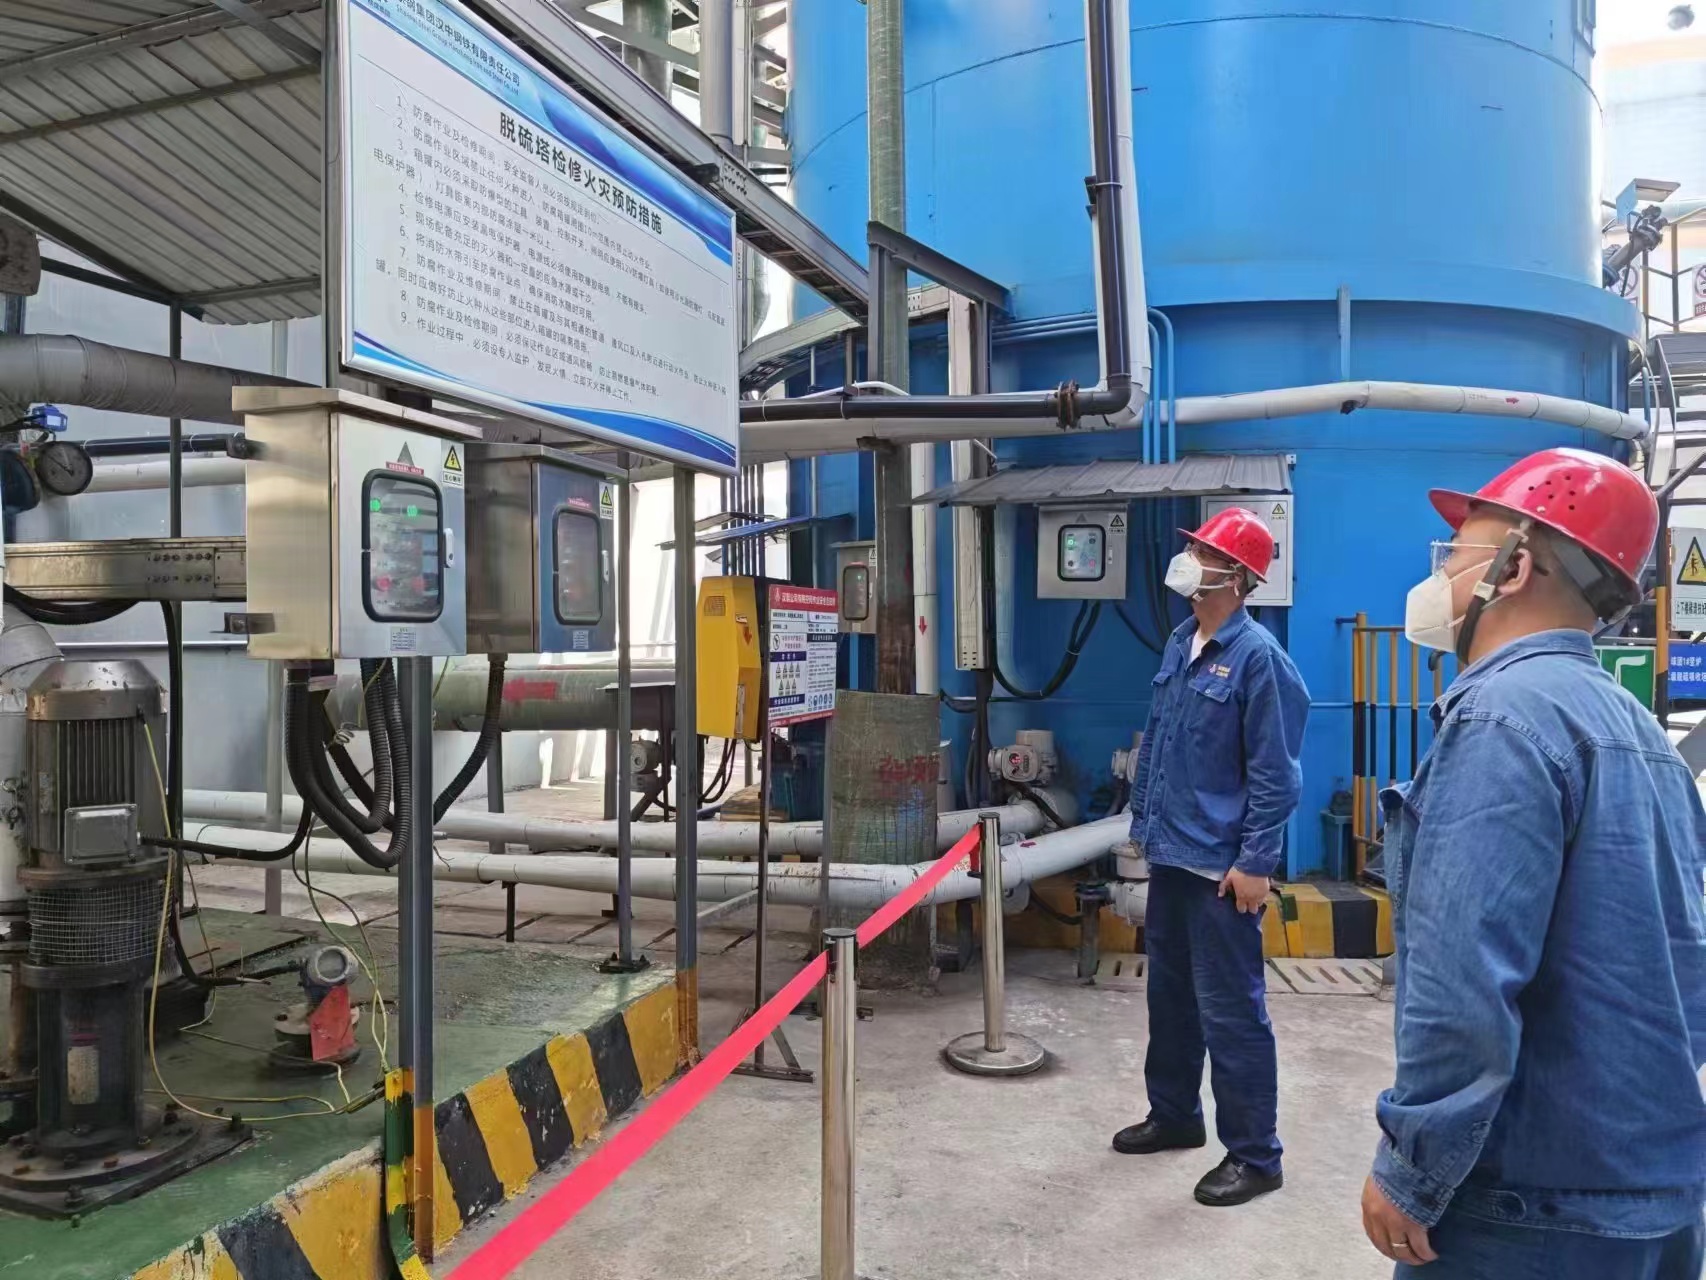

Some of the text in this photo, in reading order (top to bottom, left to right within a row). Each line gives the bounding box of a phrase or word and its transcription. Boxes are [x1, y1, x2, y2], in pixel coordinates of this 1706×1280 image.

[500, 110, 661, 236] 脱硫塔检修火灾预防措施
